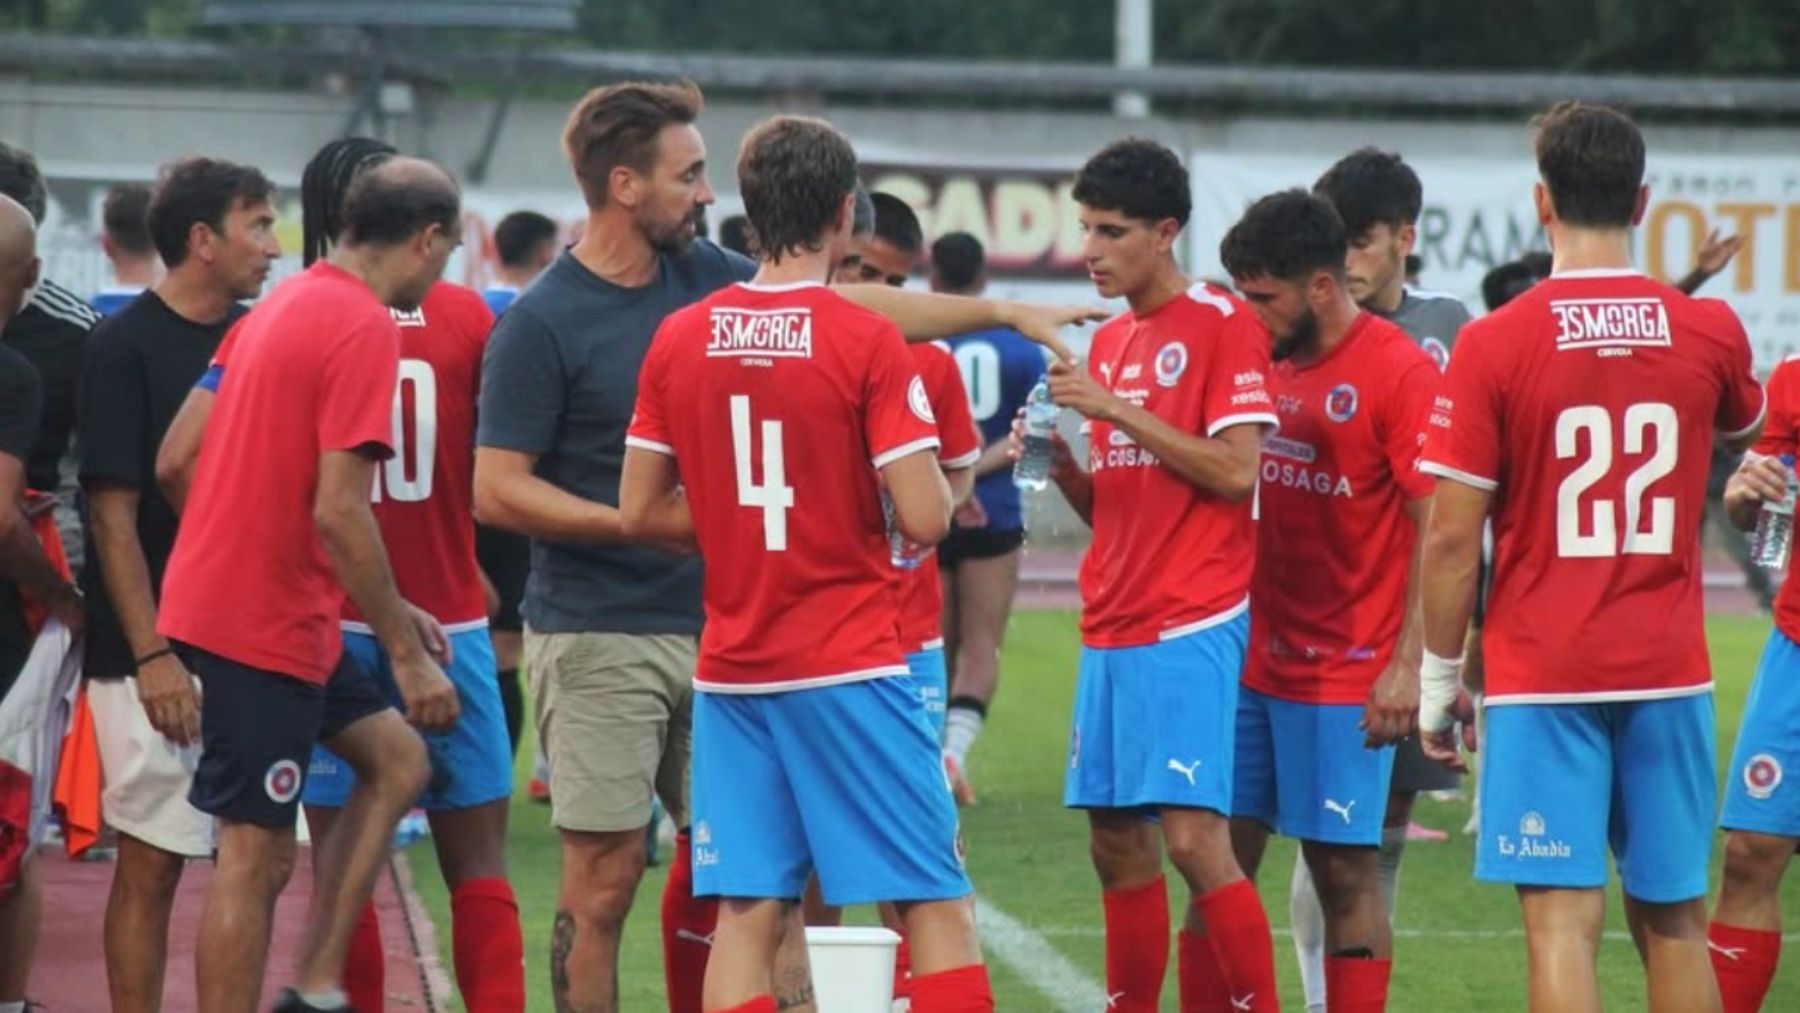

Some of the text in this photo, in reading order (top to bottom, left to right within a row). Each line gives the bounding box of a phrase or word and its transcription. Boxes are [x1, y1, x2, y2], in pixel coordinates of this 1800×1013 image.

[706, 313, 812, 358] ESMORGA
[1552, 303, 1672, 347] ESMORGA
[371, 358, 438, 503] 0
[729, 394, 795, 552] 4
[1262, 460, 1354, 498] OSAGA
[1555, 402, 1679, 558] 22
